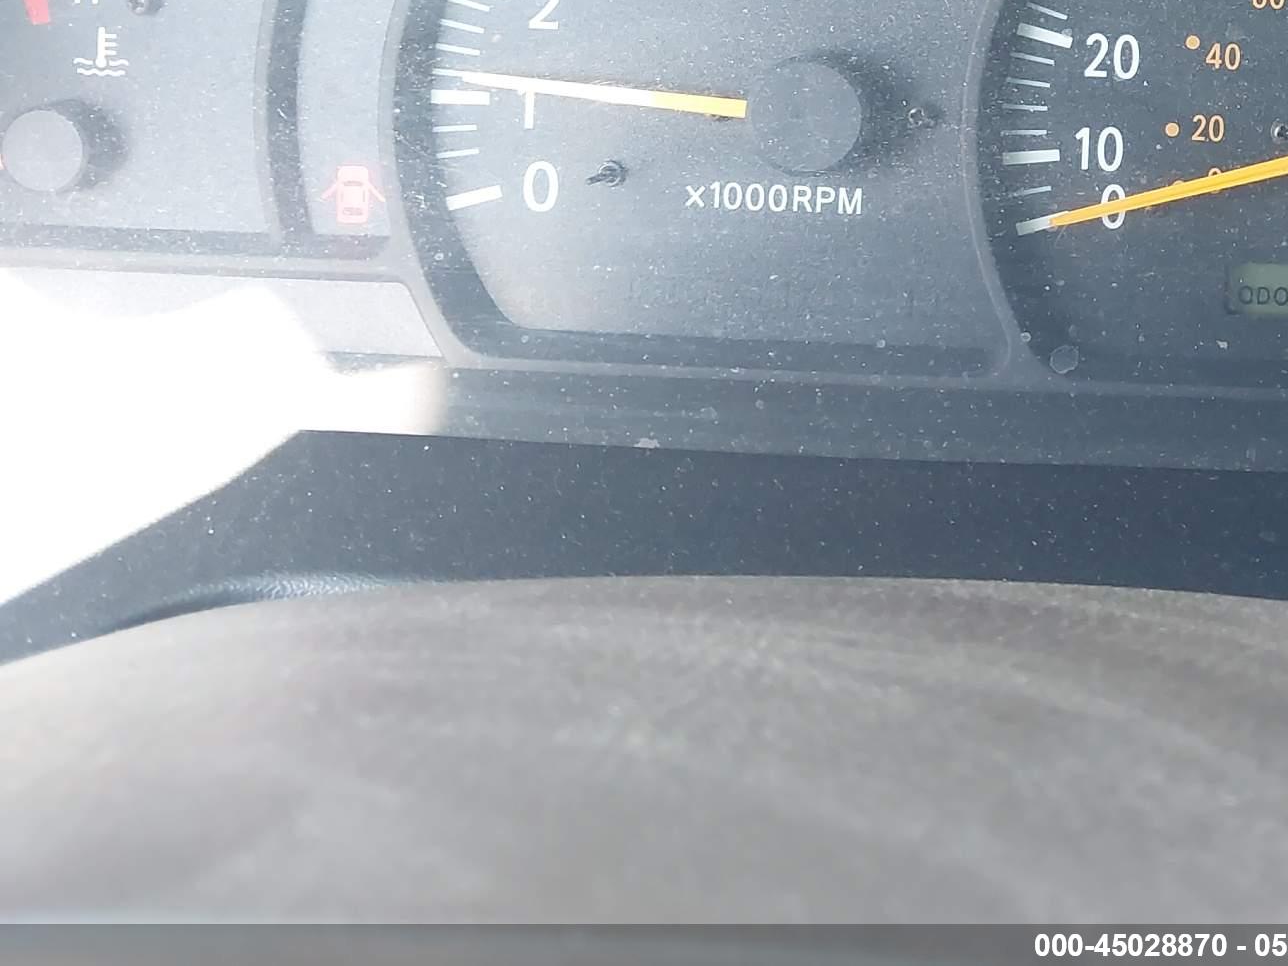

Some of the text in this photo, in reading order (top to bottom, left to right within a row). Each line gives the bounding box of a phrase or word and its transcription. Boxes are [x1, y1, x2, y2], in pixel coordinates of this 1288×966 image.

[1084, 33, 1140, 80] 20
[1205, 43, 1242, 71] 40
[1074, 126, 1125, 173] 10
[1191, 115, 1226, 142] 20
[522, 163, 559, 211] 0
[1101, 183, 1126, 230] 0
[1238, 286, 1288, 307] ODO
